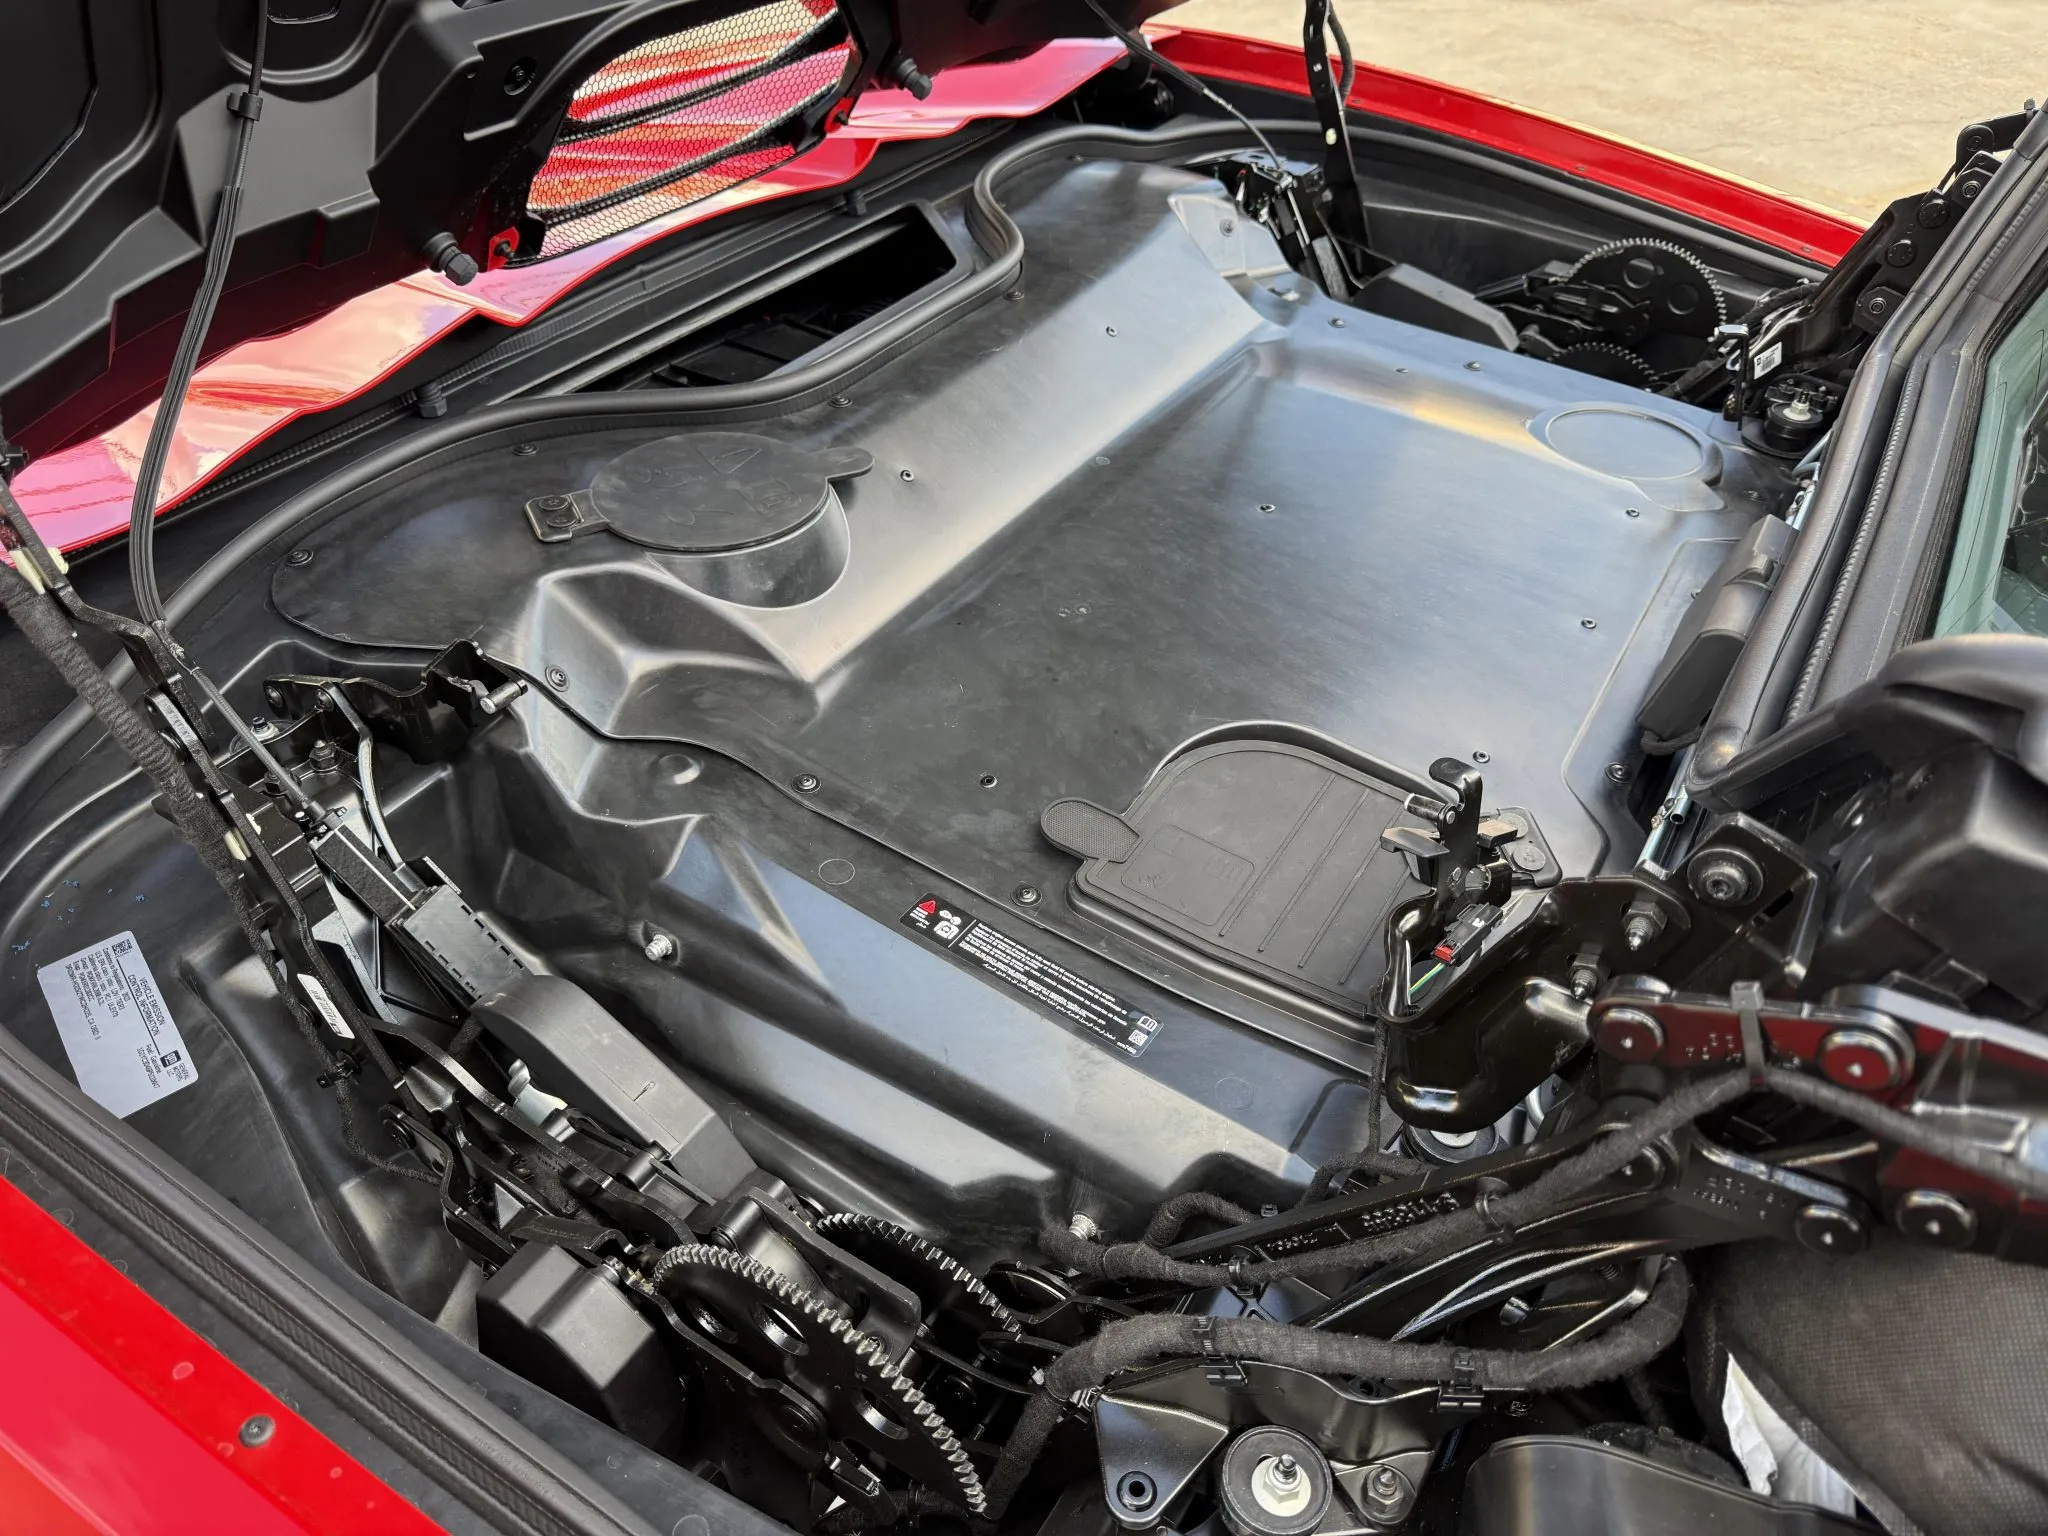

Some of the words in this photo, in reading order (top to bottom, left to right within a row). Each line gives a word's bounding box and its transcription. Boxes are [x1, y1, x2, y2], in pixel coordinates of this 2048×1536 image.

[126, 973, 145, 1000] CONTROL
[137, 998, 161, 1036] INFORMATION
[138, 976, 154, 1000] VEHICLE
[148, 998, 166, 1026] EMISSION
